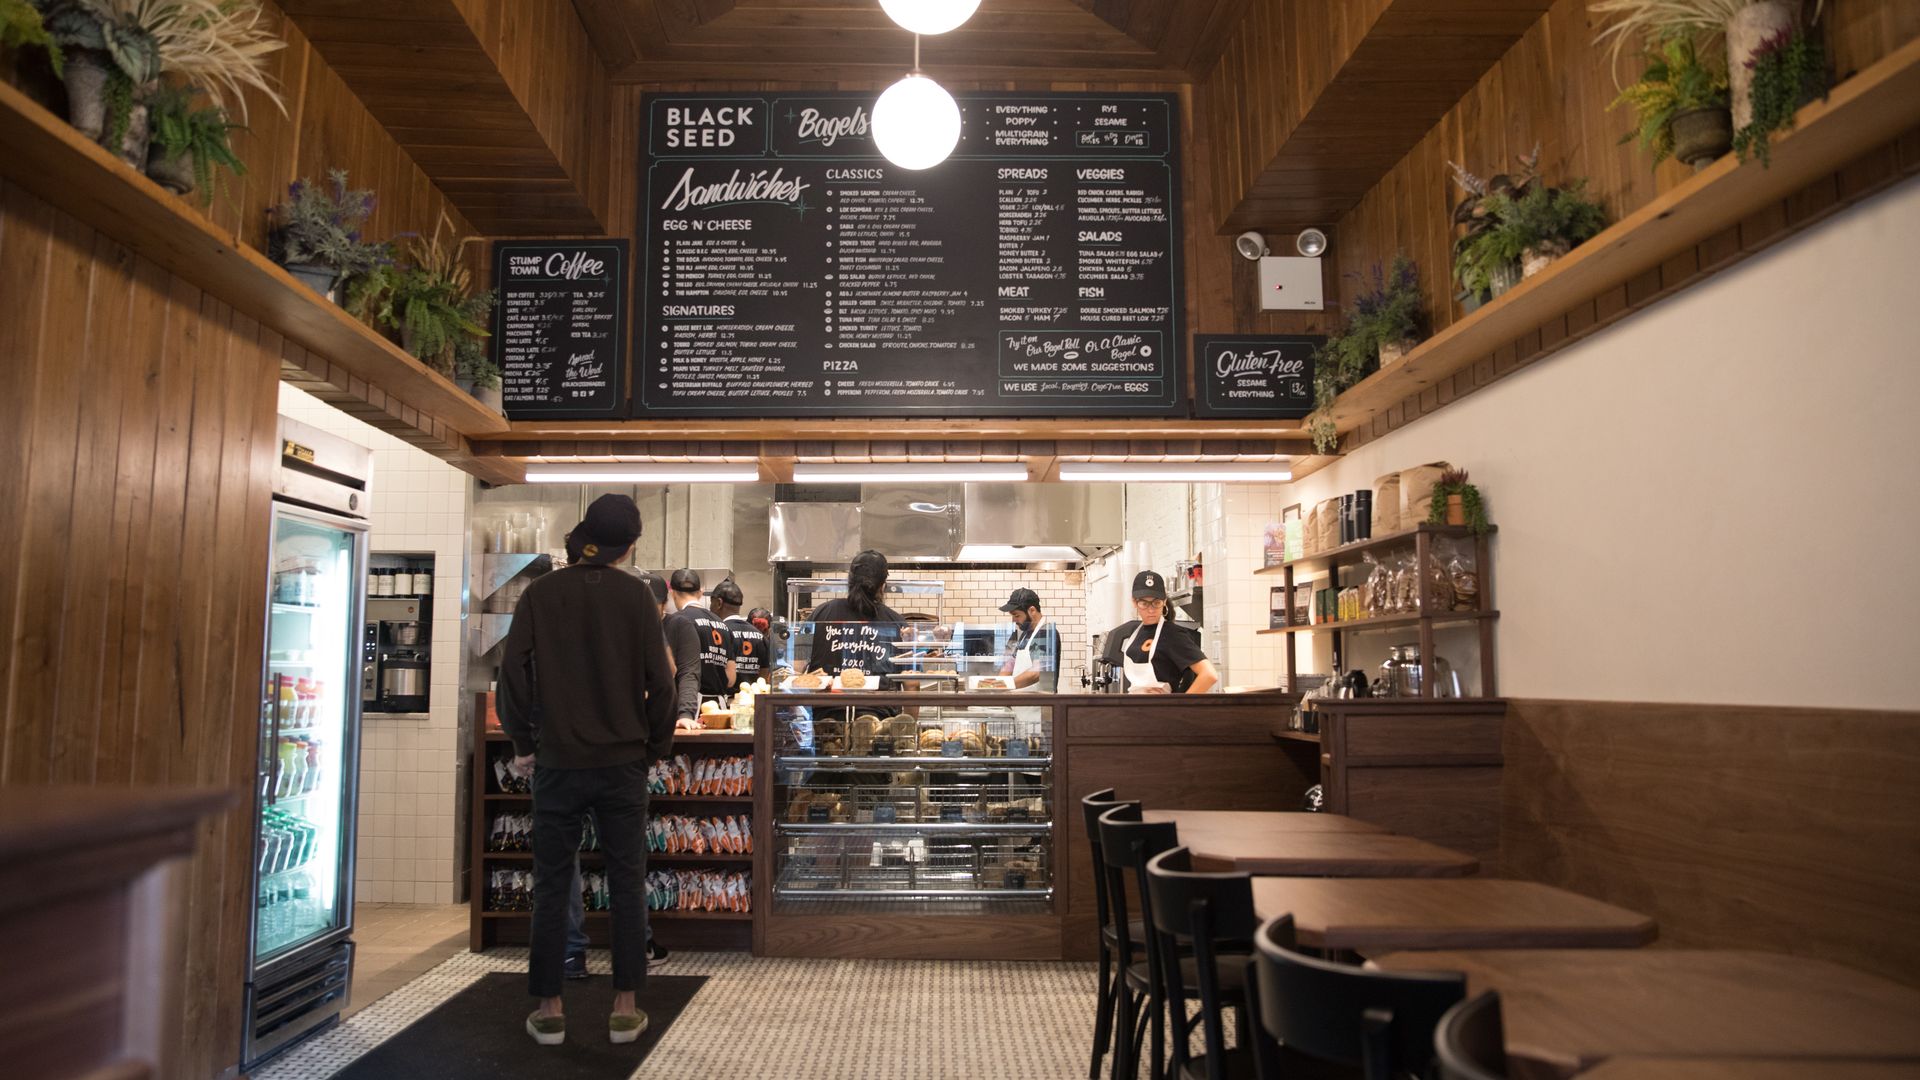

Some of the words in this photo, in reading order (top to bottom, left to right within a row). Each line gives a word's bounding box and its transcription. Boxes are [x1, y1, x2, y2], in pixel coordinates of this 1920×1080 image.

[995, 106, 1048, 114] EVERYTHING
[1101, 105, 1118, 113] RYE
[667, 107, 753, 126] BLACK
[1006, 117, 1037, 126] POPPY
[1094, 118, 1128, 126] SESAME
[798, 106, 869, 147] Bagels
[667, 128, 735, 148] SEED
[995, 130, 1049, 138] MULTIGRAIN
[995, 137, 1049, 146] EVERYTHING
[825, 169, 884, 180] CLASSICS
[997, 168, 1048, 180] SPREADS
[1076, 168, 1125, 180] VEGGIES
[661, 167, 811, 211] Sandwiches
[662, 220, 688, 231] EGG
[707, 220, 752, 231] CHEESE
[1077, 231, 1123, 242] SALADS
[509, 256, 543, 266] STUMP
[545, 251, 605, 280] Coffee
[510, 266, 540, 276] TOWN
[998, 286, 1030, 298] MEAT
[1078, 287, 1104, 298] FISH
[662, 305, 736, 316] SIGNATURES
[1042, 338, 1065, 357] Bagel
[1099, 338, 1111, 350] A
[1111, 334, 1143, 349] Classic
[1110, 346, 1137, 362] Bagel
[823, 360, 859, 371] PIZZA
[1013, 363, 1029, 372] WE
[1030, 363, 1059, 372] MADE
[1061, 363, 1088, 372] SOME
[1091, 363, 1155, 372] SUGGESTIONS
[1216, 350, 1269, 378] Gluten
[1262, 350, 1305, 375] Free
[578, 362, 603, 378] Word
[1004, 383, 1020, 392] WE
[1020, 383, 1038, 392] USE
[1124, 383, 1150, 392] EGGS
[1236, 379, 1267, 387] SESAME
[1228, 390, 1275, 399] EVERYTHING
[732, 630, 742, 639] HY
[825, 625, 855, 641] You're
[860, 625, 879, 641] My
[830, 639, 887, 660] Everything
[841, 657, 864, 668] XOXO
